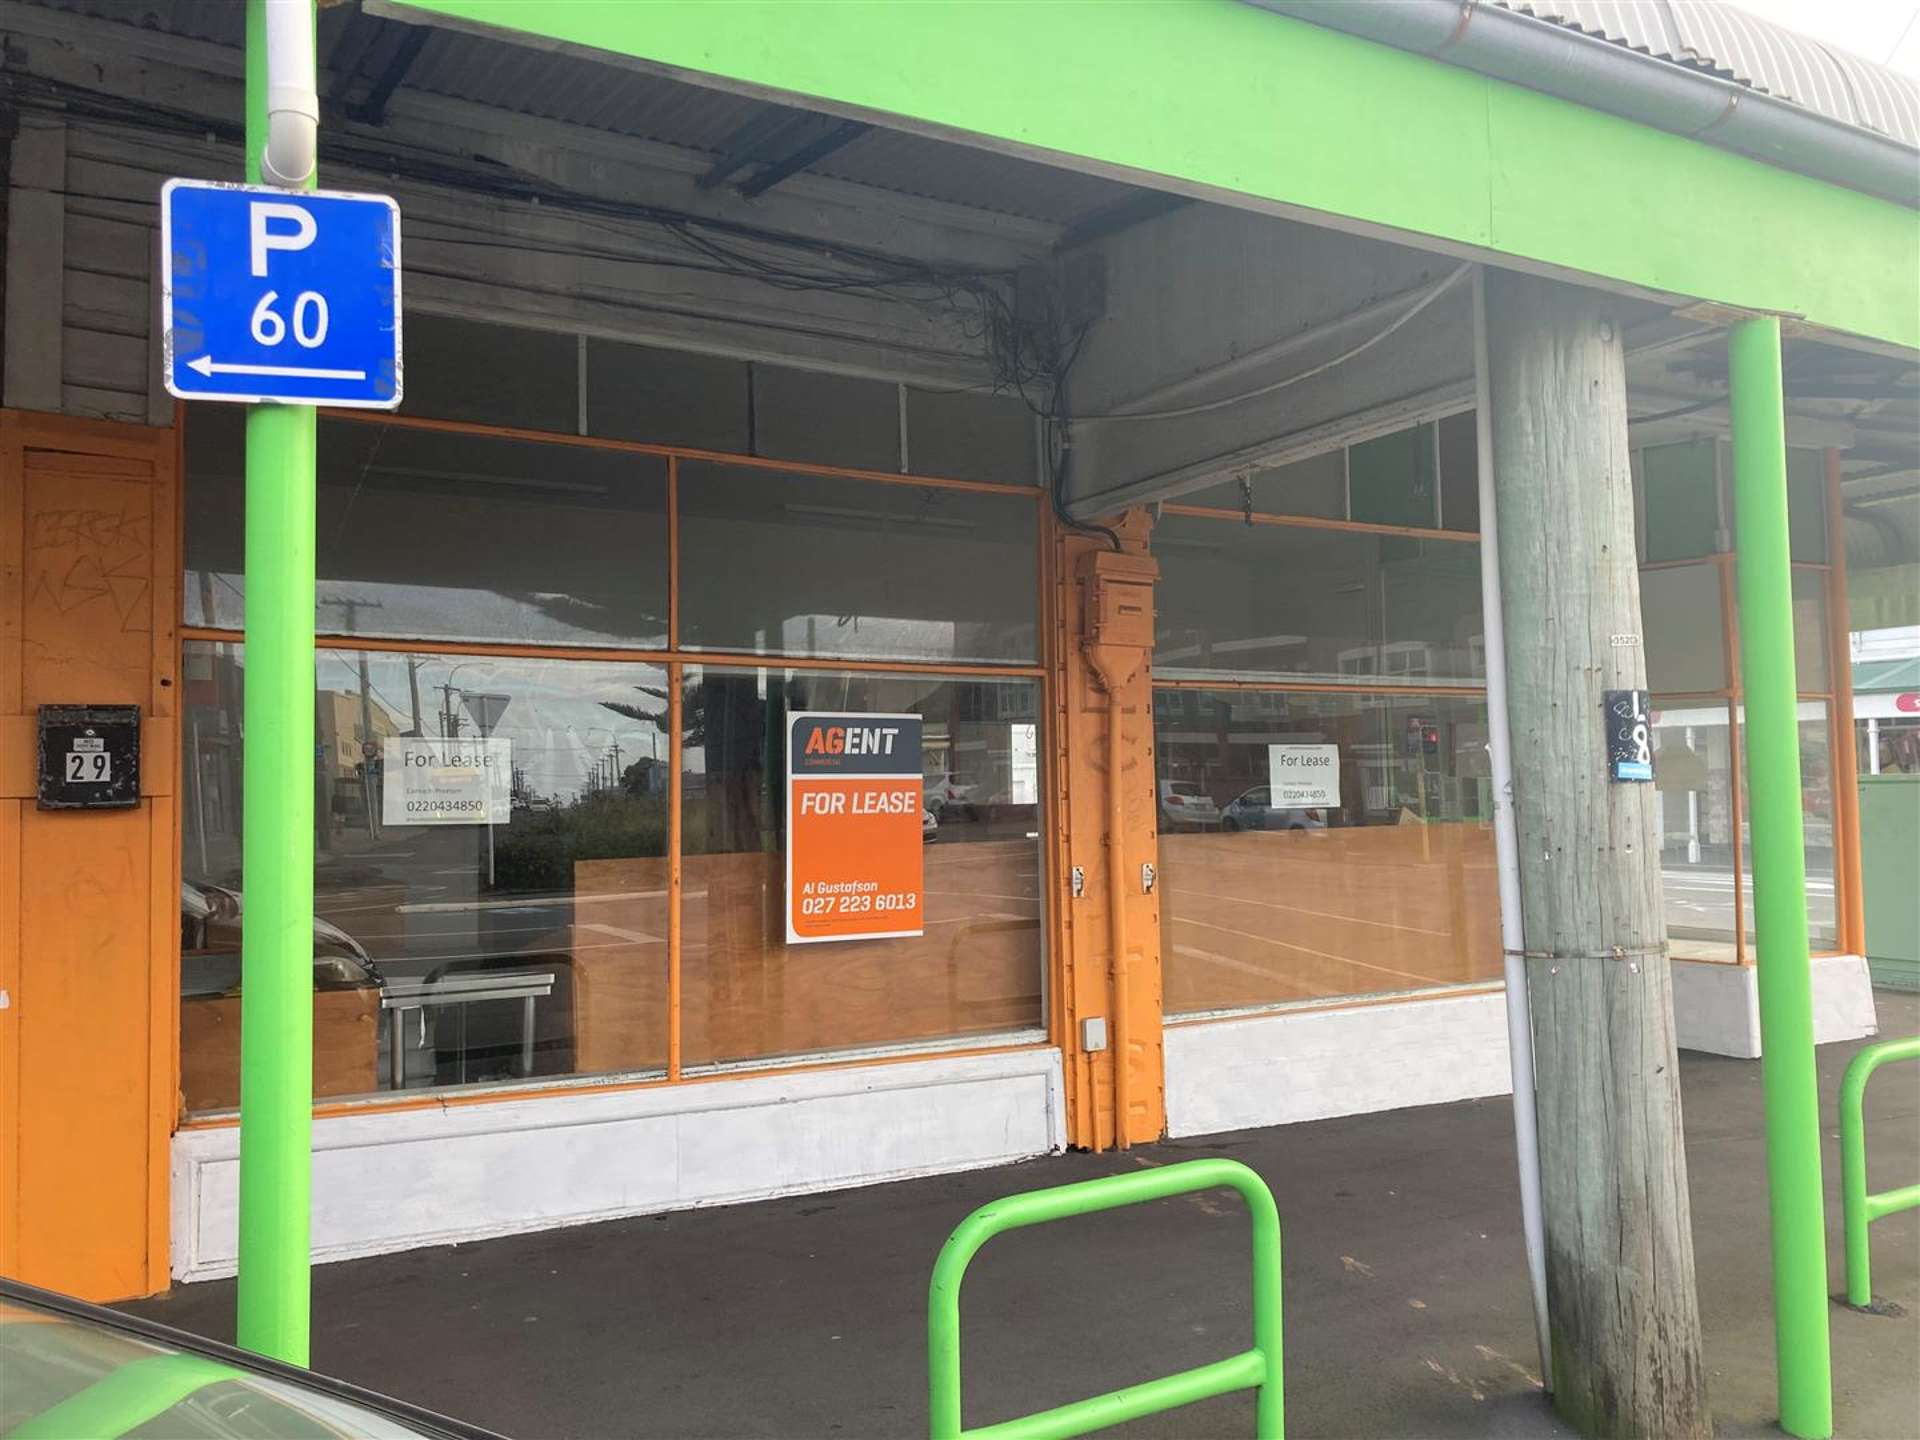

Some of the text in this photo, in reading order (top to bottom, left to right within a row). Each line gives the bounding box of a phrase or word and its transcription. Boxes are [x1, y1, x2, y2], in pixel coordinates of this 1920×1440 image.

[251, 201, 318, 278] P
[251, 290, 329, 348] 60
[804, 726, 900, 755] AGENT
[71, 754, 106, 780] 29
[404, 751, 493, 768] For Lease
[1280, 754, 1330, 767] For Lease
[406, 800, 483, 812] 0220434850
[800, 791, 917, 815] FOR LEASE
[802, 880, 878, 895] Al Gustafson
[802, 893, 917, 915] 027 223 6013
